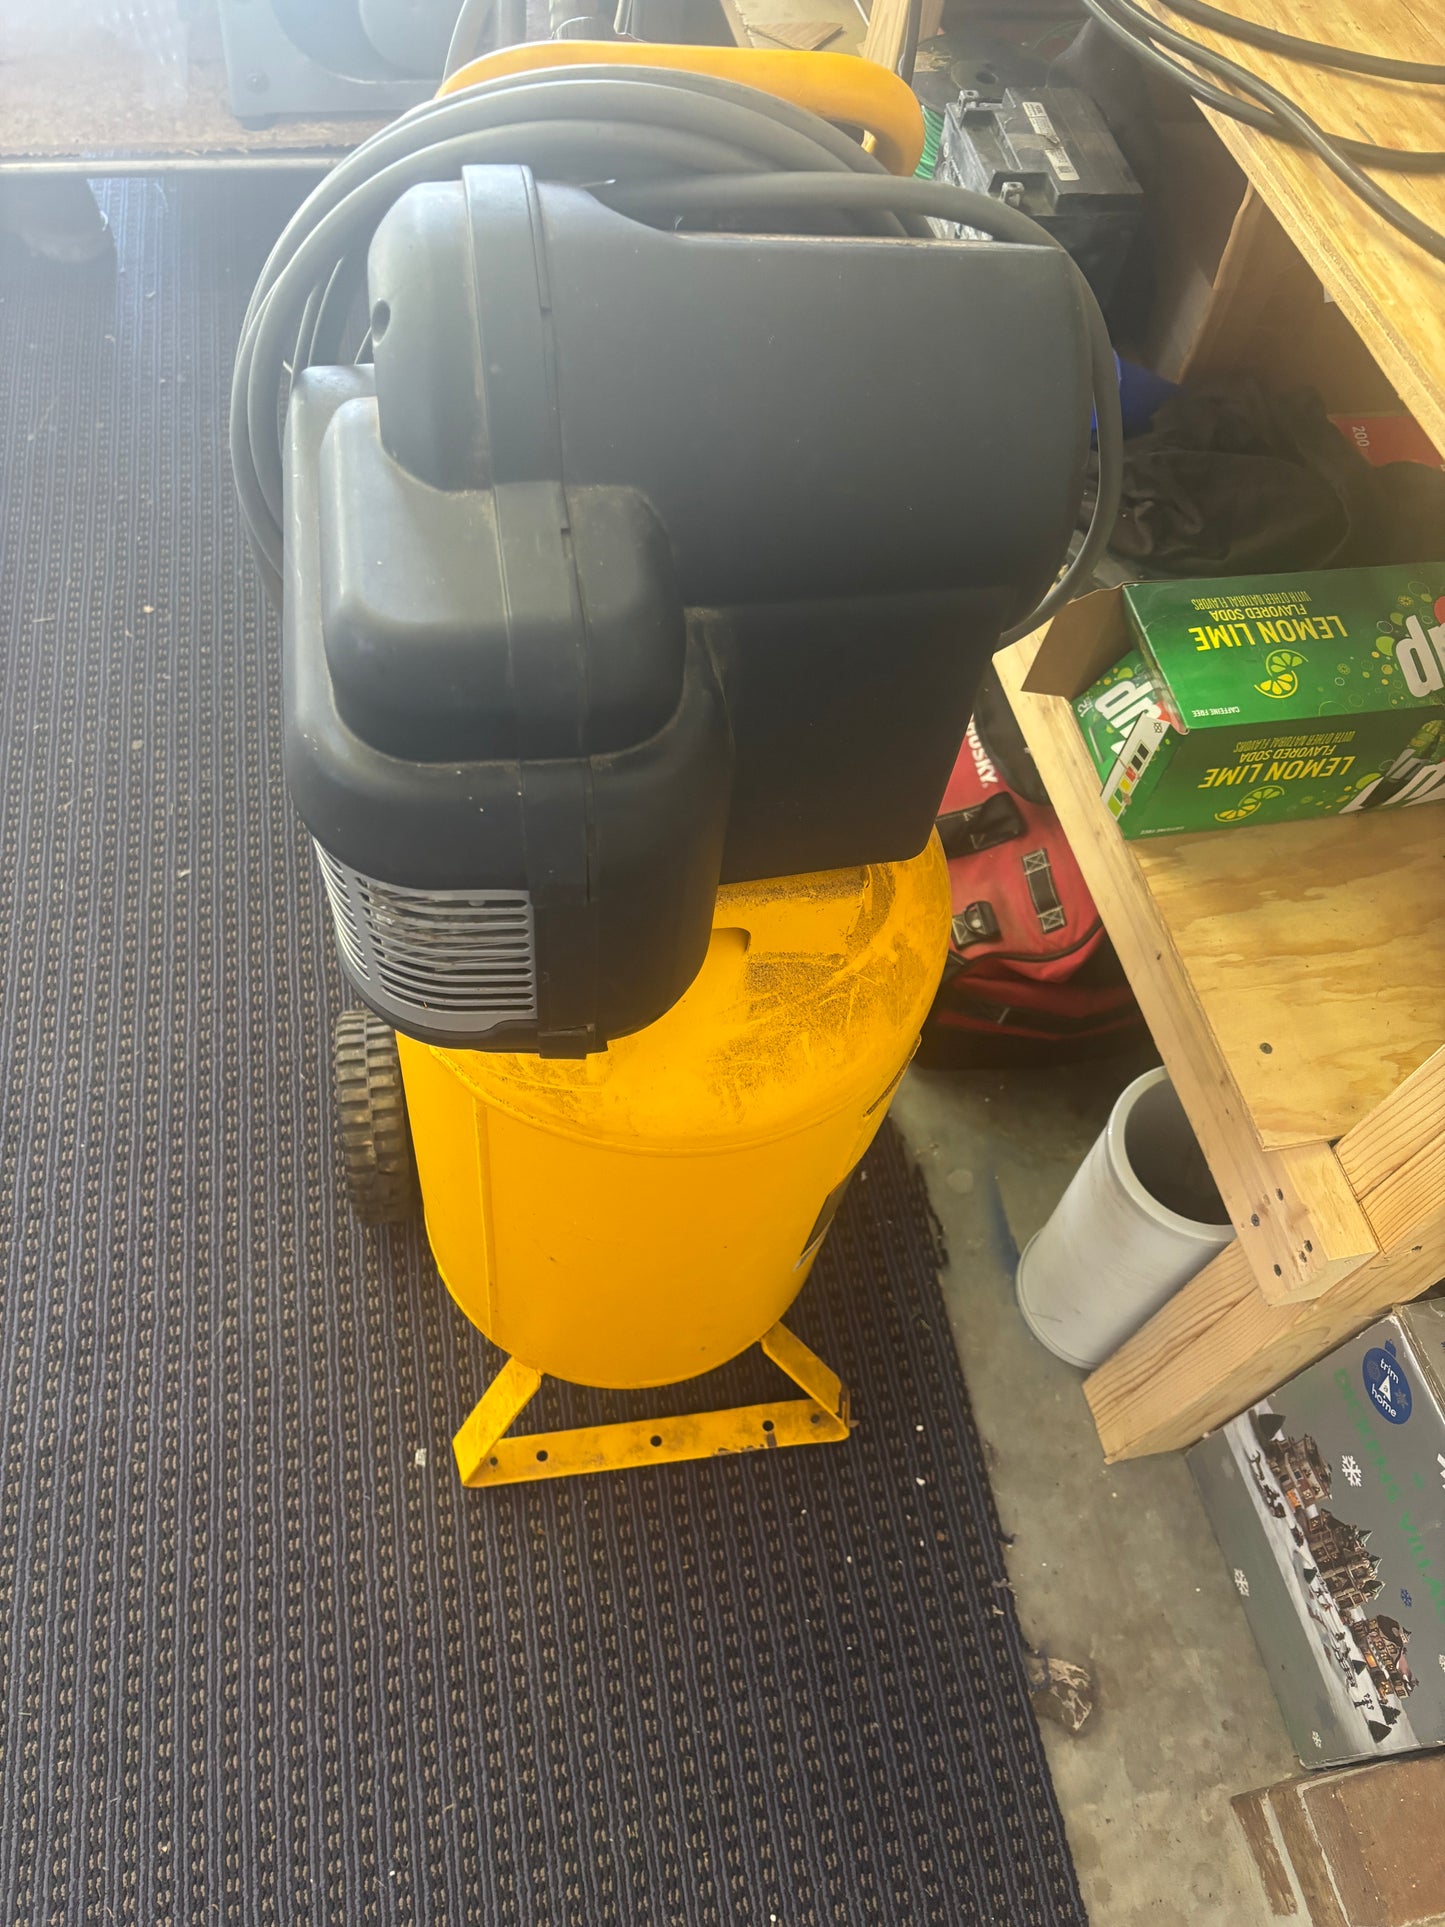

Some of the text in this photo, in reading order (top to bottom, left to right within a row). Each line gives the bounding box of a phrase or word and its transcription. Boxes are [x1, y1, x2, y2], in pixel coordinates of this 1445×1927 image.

[1352, 425, 1370, 448] 200
[1191, 597, 1228, 610] FLAVORS
[1226, 594, 1264, 608] NATURAL
[1263, 592, 1291, 605] OTHER
[1208, 603, 1307, 622] FLAVORED SODA
[1188, 615, 1348, 651] LEMON LIME
[1191, 709, 1210, 718] FREE
[1239, 745, 1337, 763] FLAVORED SODA
[1197, 763, 1265, 789] LIME
[1263, 756, 1356, 782] LEMON
[1380, 1358, 1399, 1384] trim
[1371, 1383, 1397, 1418] home
